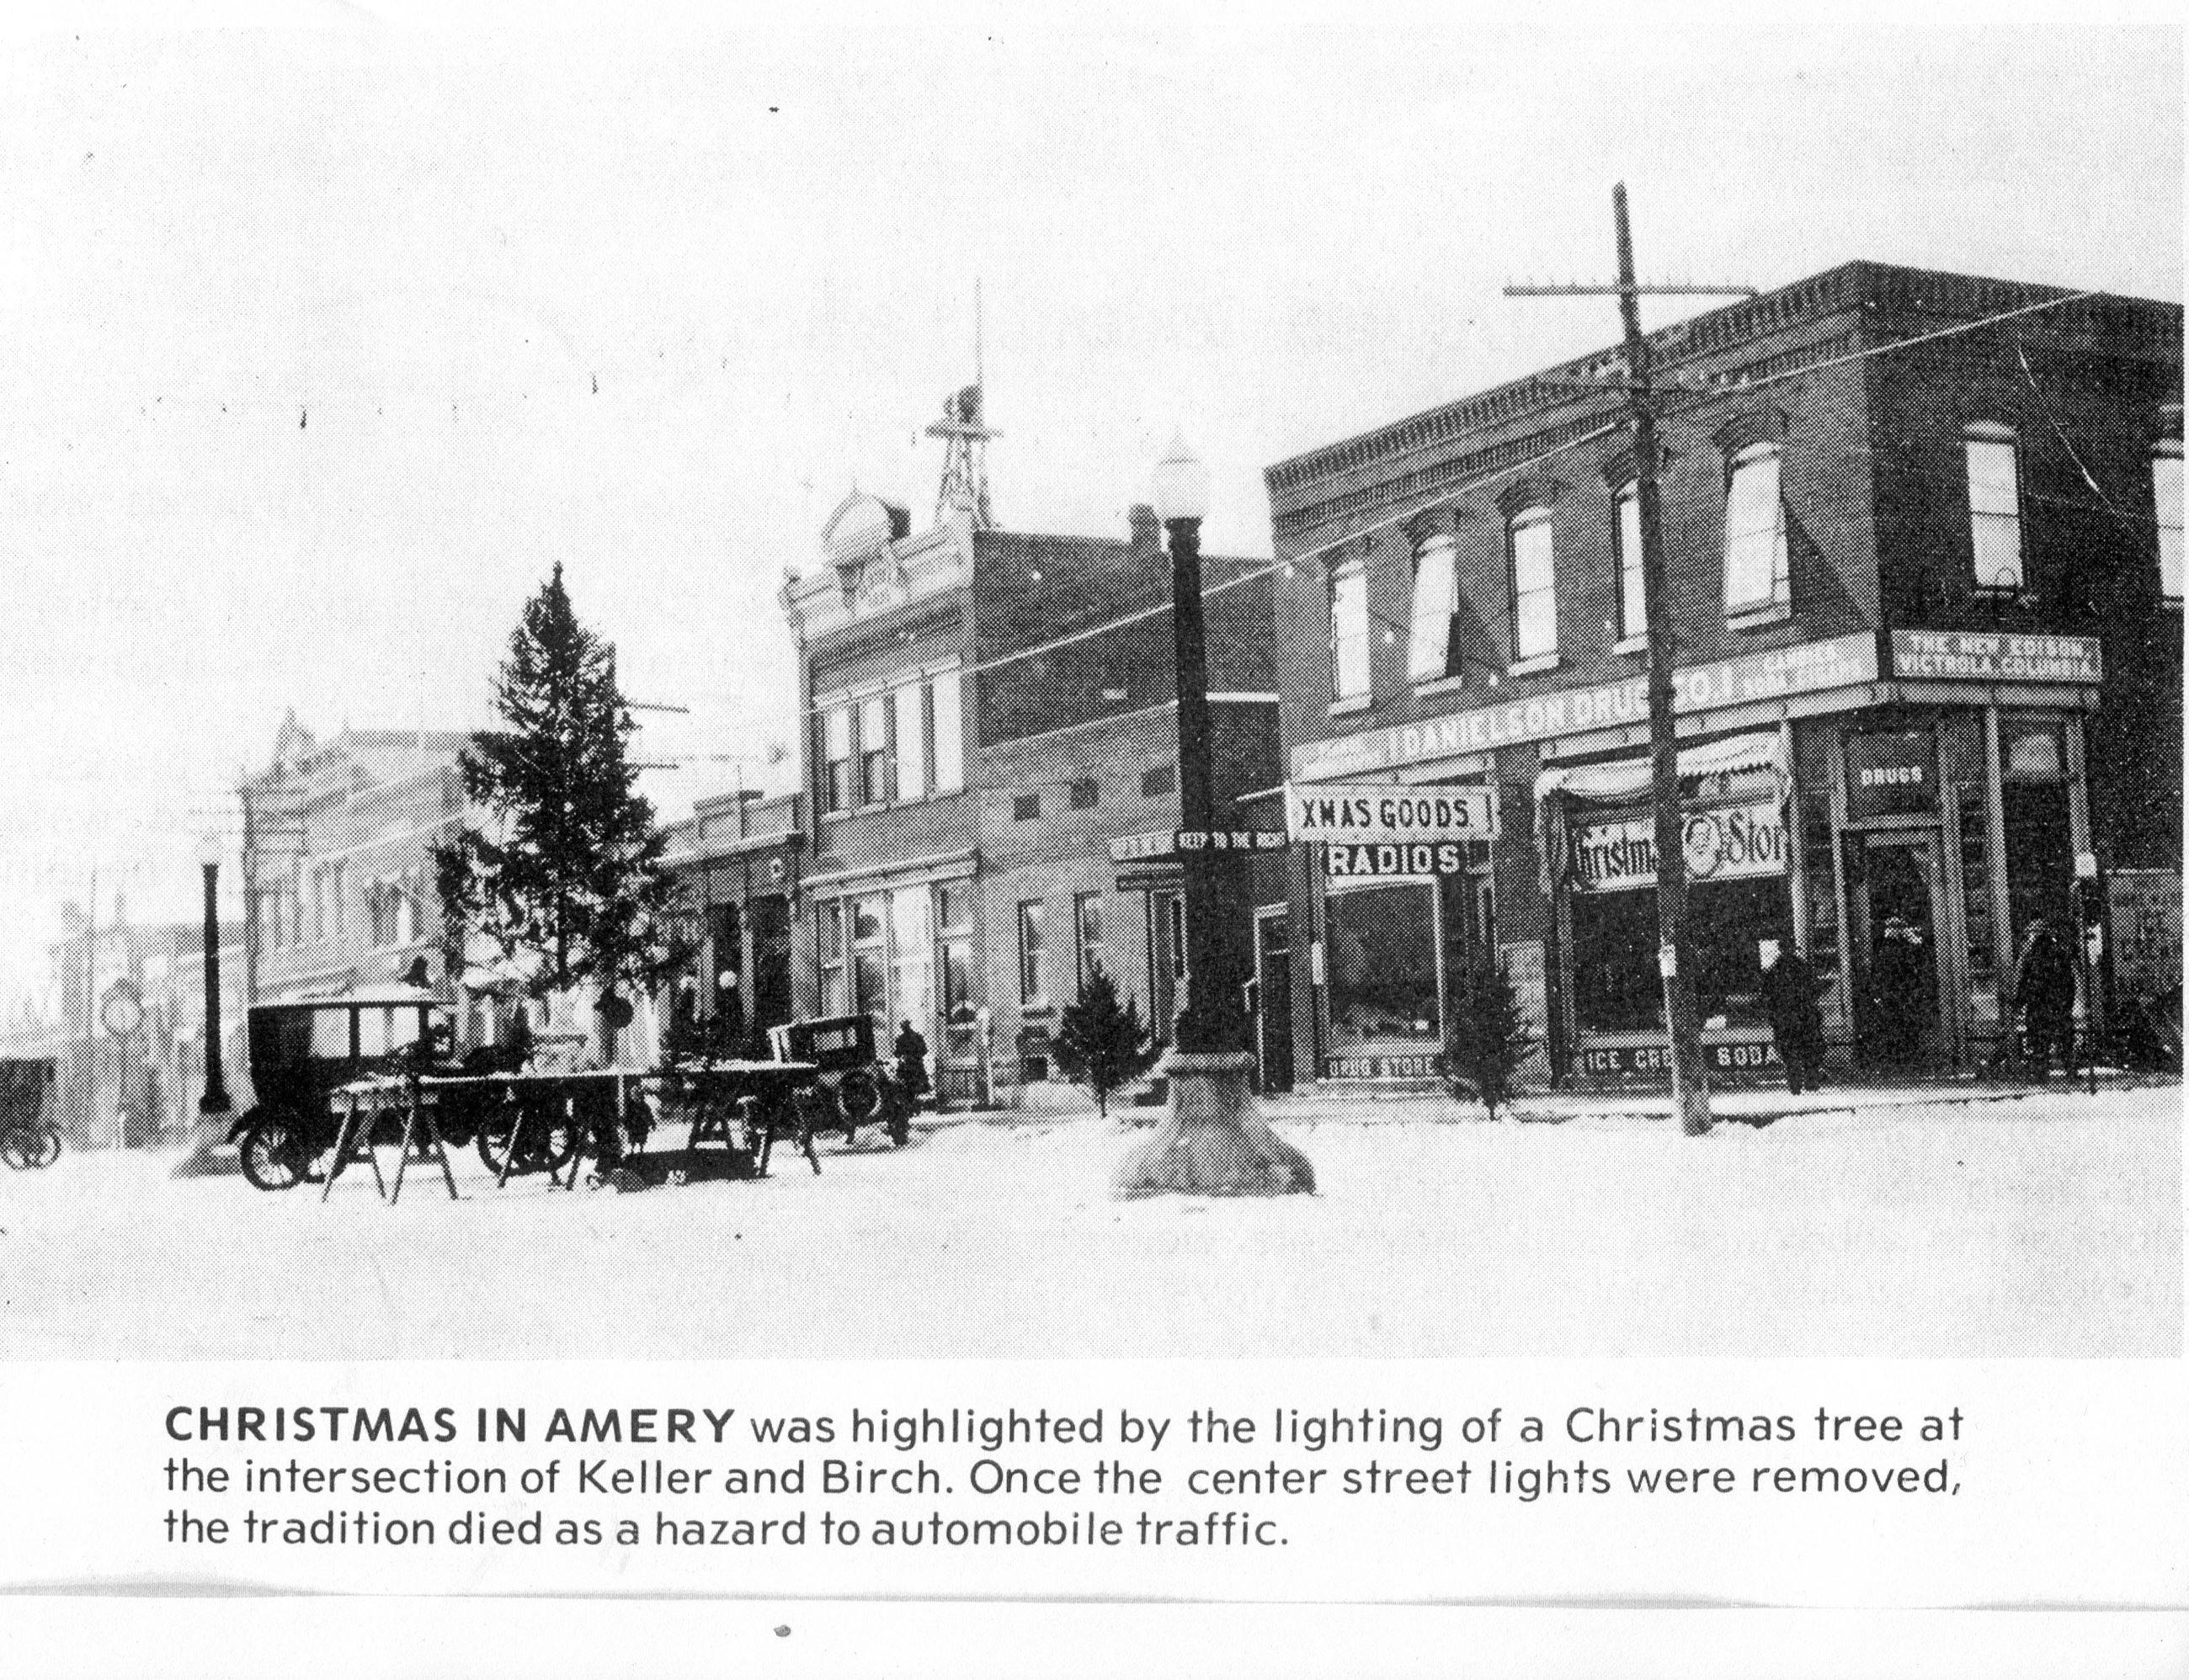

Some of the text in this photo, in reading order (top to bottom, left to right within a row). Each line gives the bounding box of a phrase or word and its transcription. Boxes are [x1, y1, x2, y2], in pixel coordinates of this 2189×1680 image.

[1909, 635, 1949, 653] THE
[1959, 637, 2000, 655] NEW
[1403, 699, 1565, 756] DANIELSON
[1573, 678, 1650, 726] DRUG
[1861, 764, 1923, 787] DRUGS
[1302, 798, 1372, 829] XMAS
[1212, 830, 1228, 849] TO
[1230, 830, 1252, 849] THE
[1568, 811, 1788, 891] Christm Stor
[1328, 843, 1460, 875] RADIOS
[1329, 1056, 1435, 1077] DRUG STORE
[1588, 1045, 1782, 1070] ICE CRE SODA
